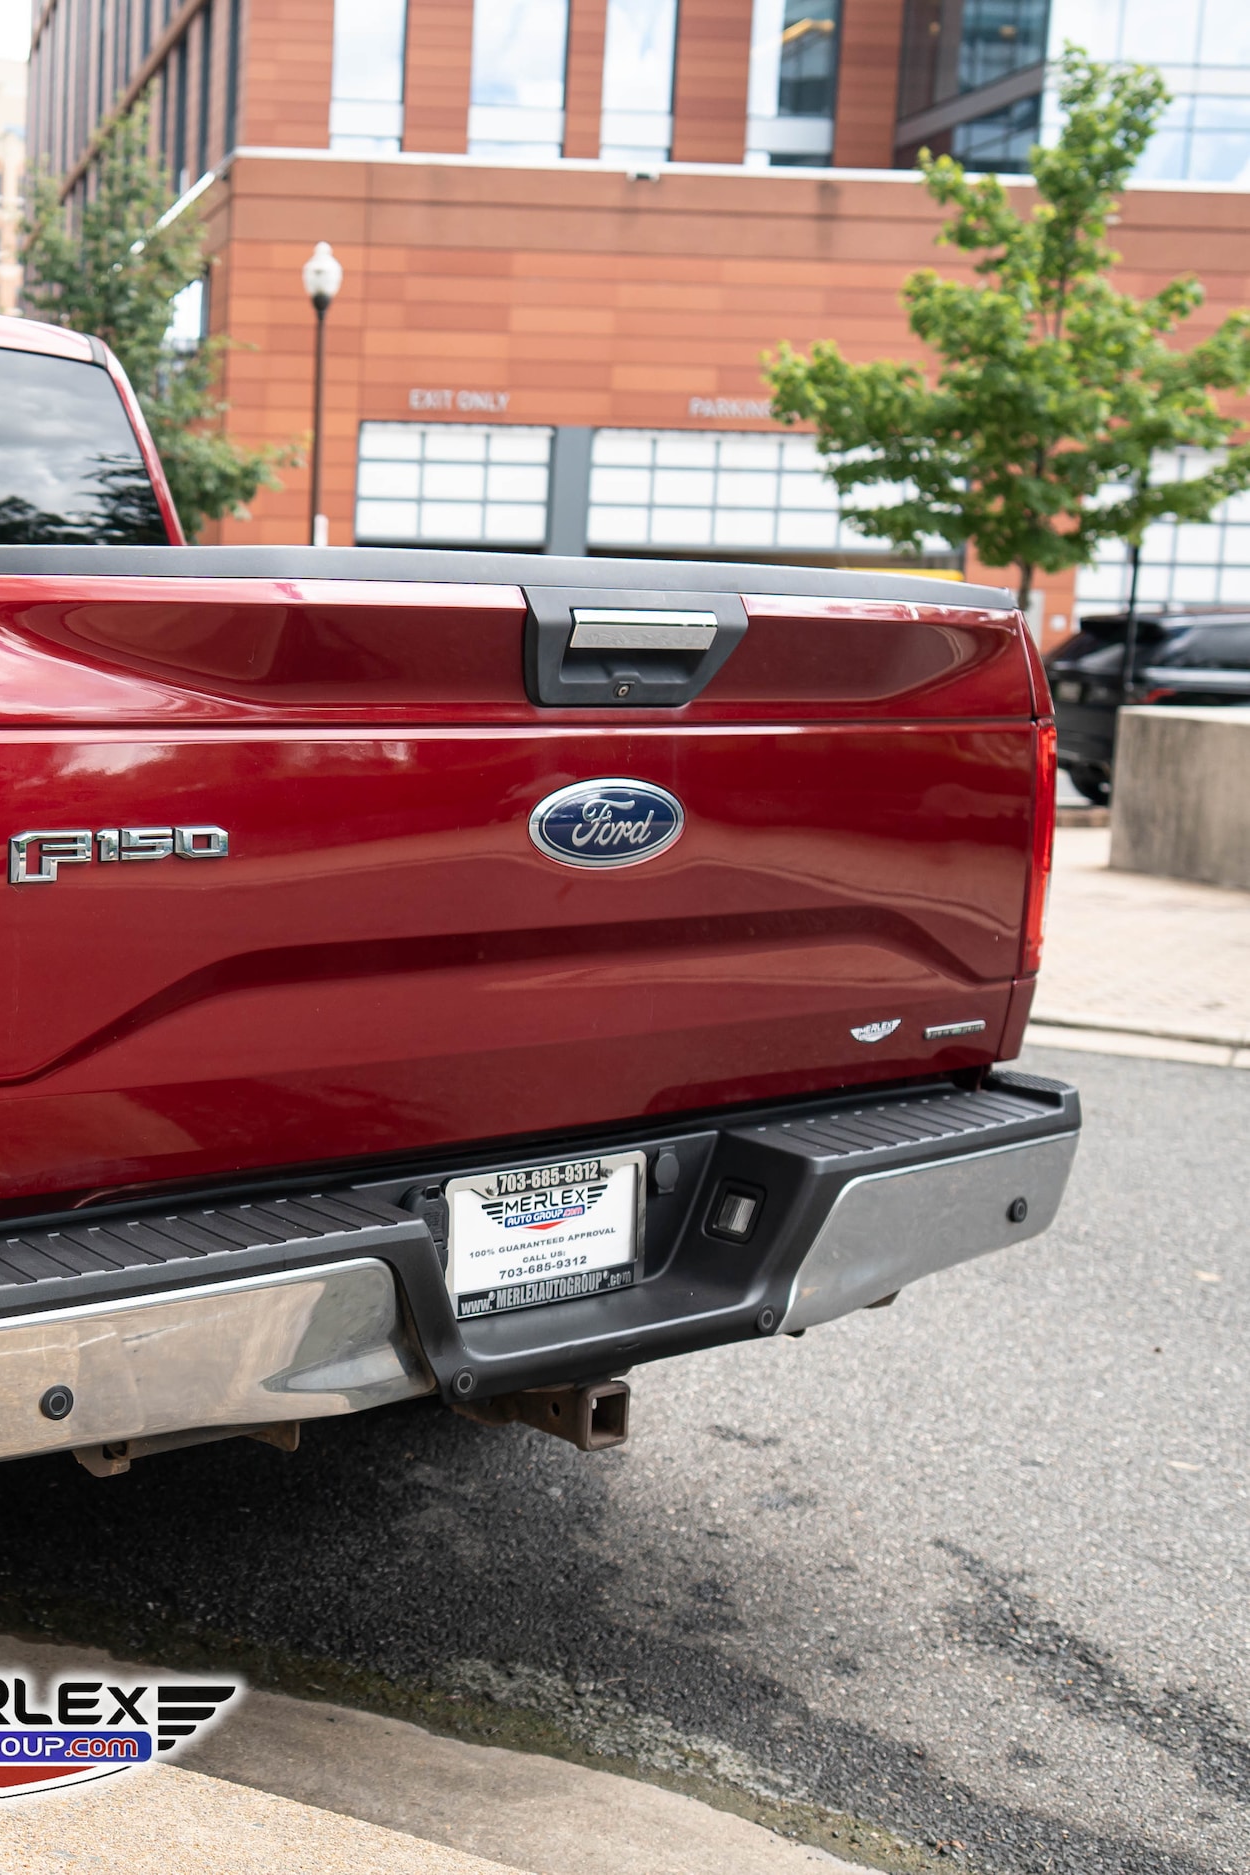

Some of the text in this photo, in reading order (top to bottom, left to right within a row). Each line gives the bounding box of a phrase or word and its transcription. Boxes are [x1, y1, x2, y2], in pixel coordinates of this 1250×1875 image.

[409, 389, 510, 412] EXIT ONLY
[572, 799, 654, 847] Ford
[499, 1161, 599, 1194] 703-685-9312
[504, 1188, 585, 1214] MERLEX
[507, 1213, 533, 1226] AUTO
[469, 1227, 616, 1259] 100% GUARANTEED APPROVAL
[499, 1255, 587, 1280] 703-685-9312
[523, 1250, 566, 1263] CALL US:
